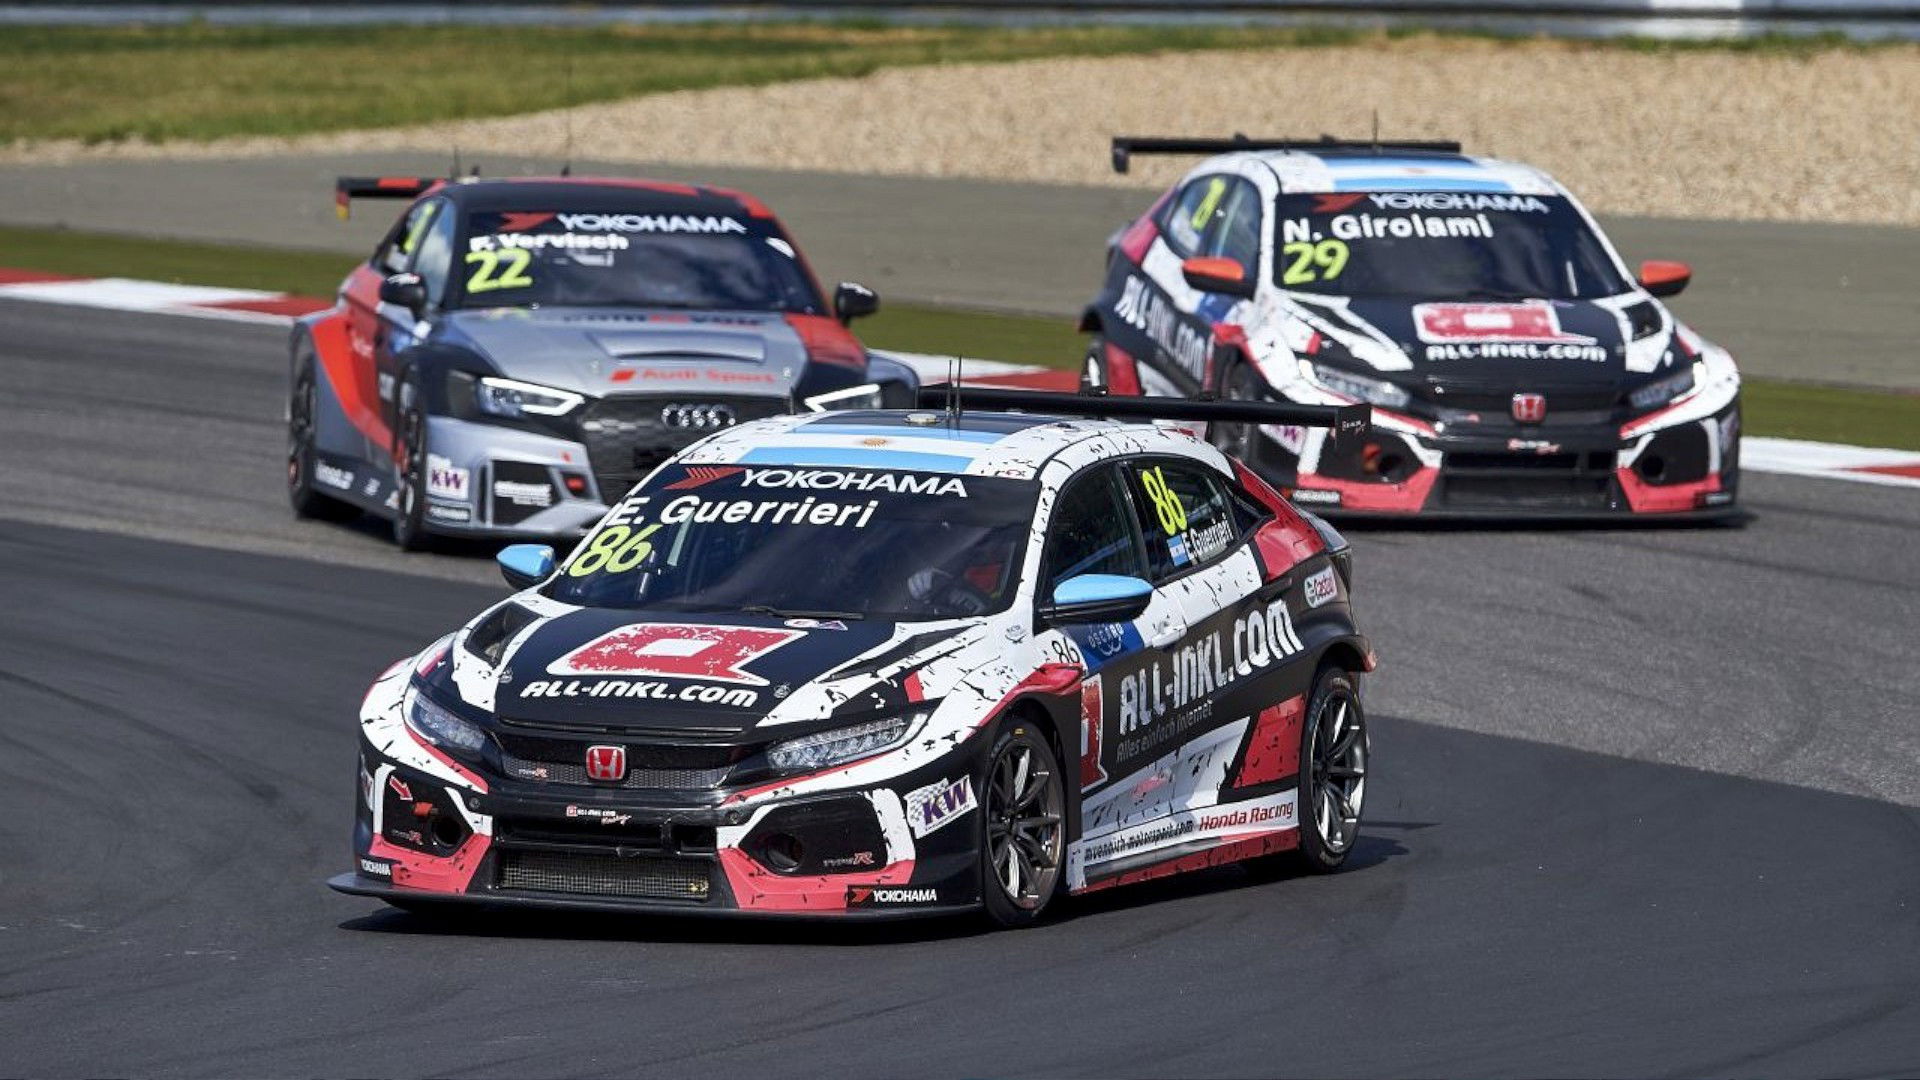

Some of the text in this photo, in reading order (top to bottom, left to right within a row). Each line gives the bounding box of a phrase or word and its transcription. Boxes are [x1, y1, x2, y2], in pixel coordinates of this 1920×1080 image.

[1369, 193, 1549, 213] YOKOHAMA
[557, 214, 747, 233] YOKOHAMA
[1283, 213, 1494, 243] N. Girolami
[498, 231, 629, 250] Vervisch
[466, 248, 532, 293] 22
[1283, 239, 1350, 285] 29
[431, 469, 462, 490] KW
[740, 469, 968, 498] YOKOHAMA
[606, 495, 879, 529] E. Guerrieri
[1142, 466, 1188, 536] 86
[568, 522, 663, 578] 86
[922, 776, 970, 826] KW
[1199, 801, 1294, 832] Honda Racing
[873, 888, 937, 903] YOKOHAMA
